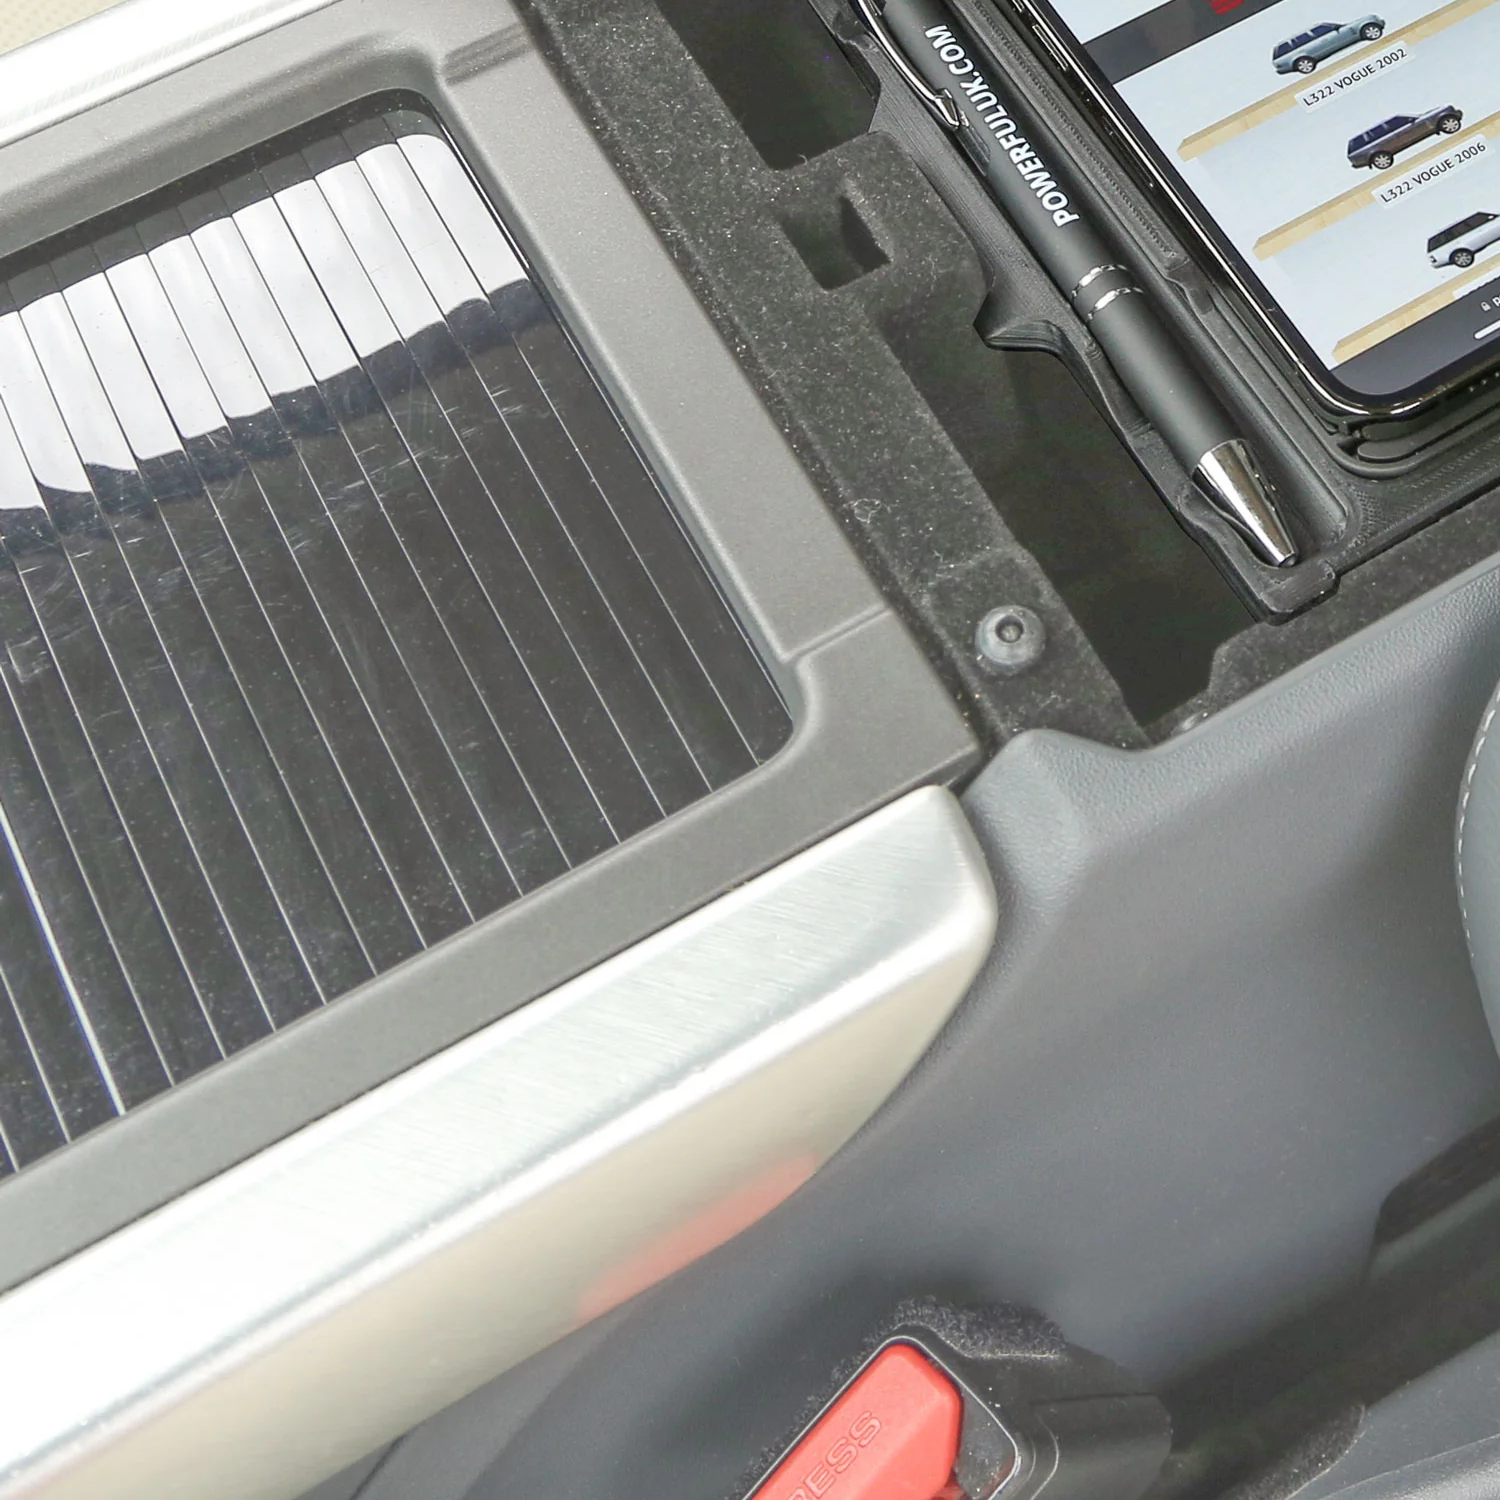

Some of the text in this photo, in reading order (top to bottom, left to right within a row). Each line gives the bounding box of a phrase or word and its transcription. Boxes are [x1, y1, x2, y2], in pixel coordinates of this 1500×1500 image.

[1303, 48, 1408, 107] L322 VOGUE 2002
[925, 24, 1080, 228] POWERFULUK.COM
[1380, 141, 1487, 203] L322 VOGUE 2006
